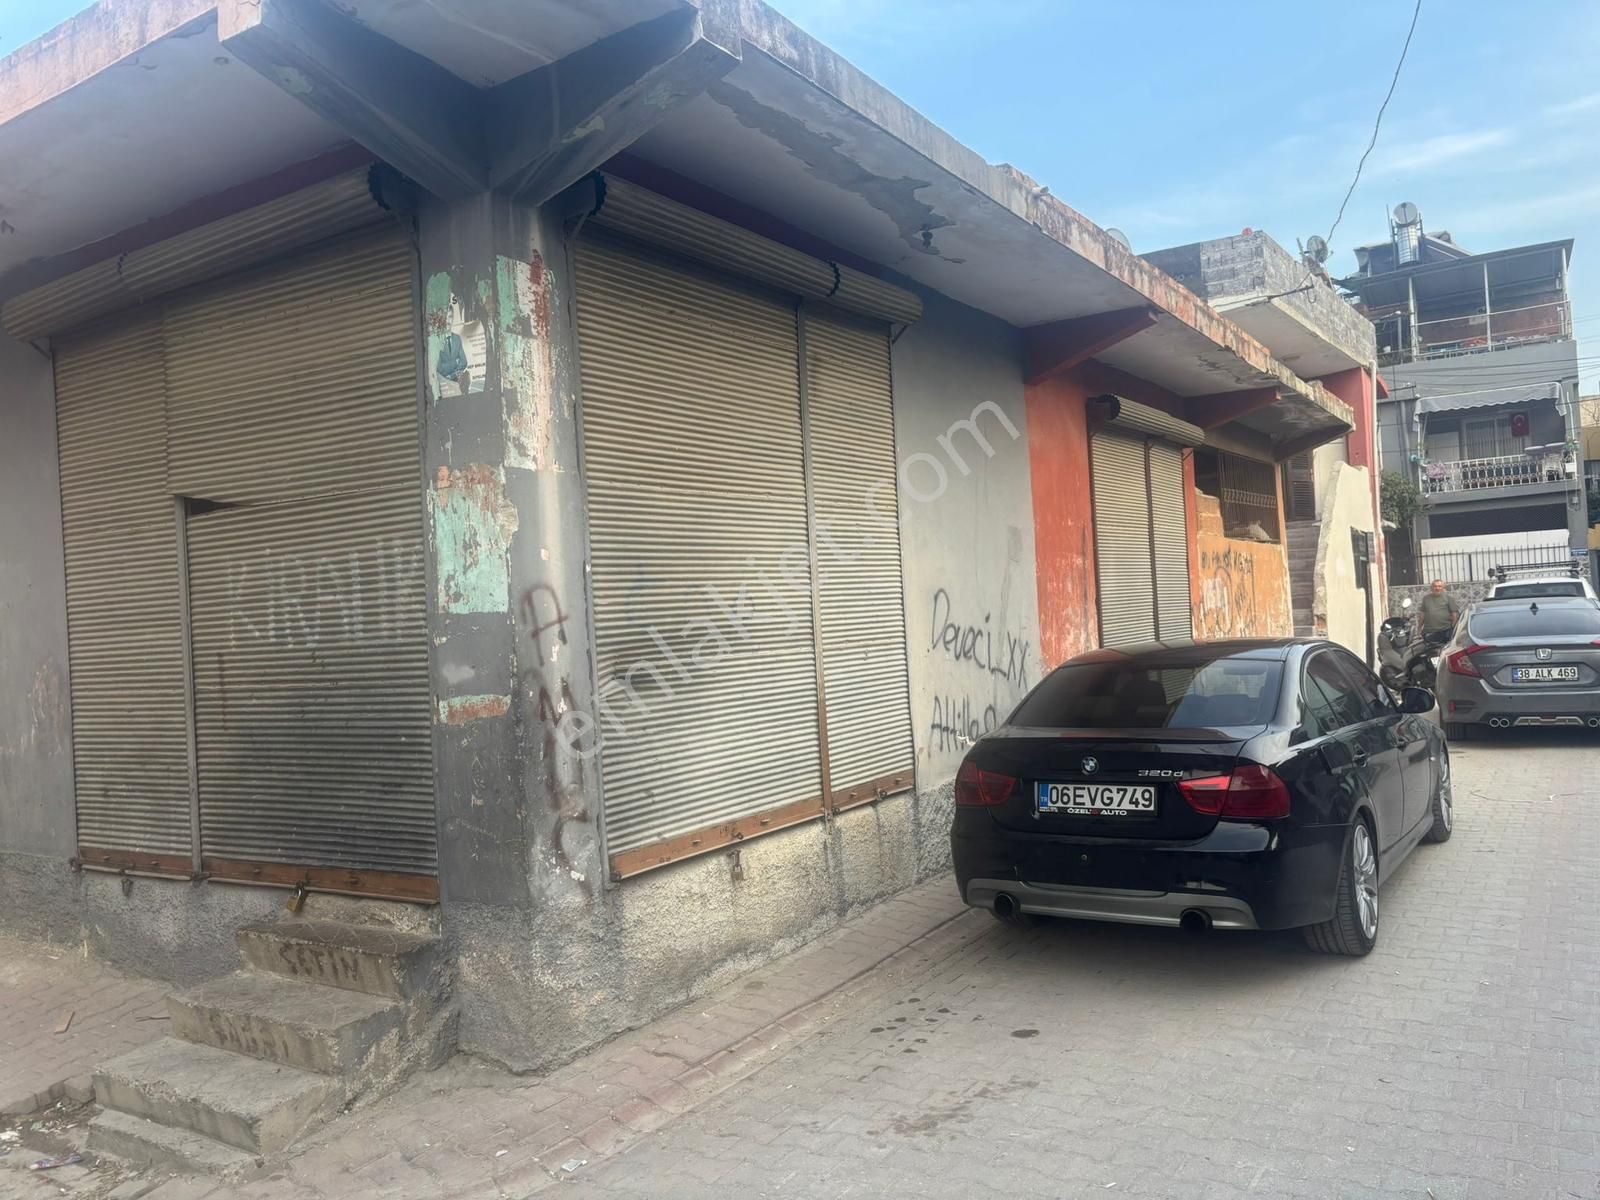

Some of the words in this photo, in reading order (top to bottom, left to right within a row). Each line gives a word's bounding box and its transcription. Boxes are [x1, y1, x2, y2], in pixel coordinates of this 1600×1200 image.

[1518, 669, 1530, 679] 38
[1535, 669, 1553, 678] ALK
[1557, 667, 1577, 678] 469
[1138, 769, 1184, 777] 320d
[1049, 785, 1153, 809] 06EVG749
